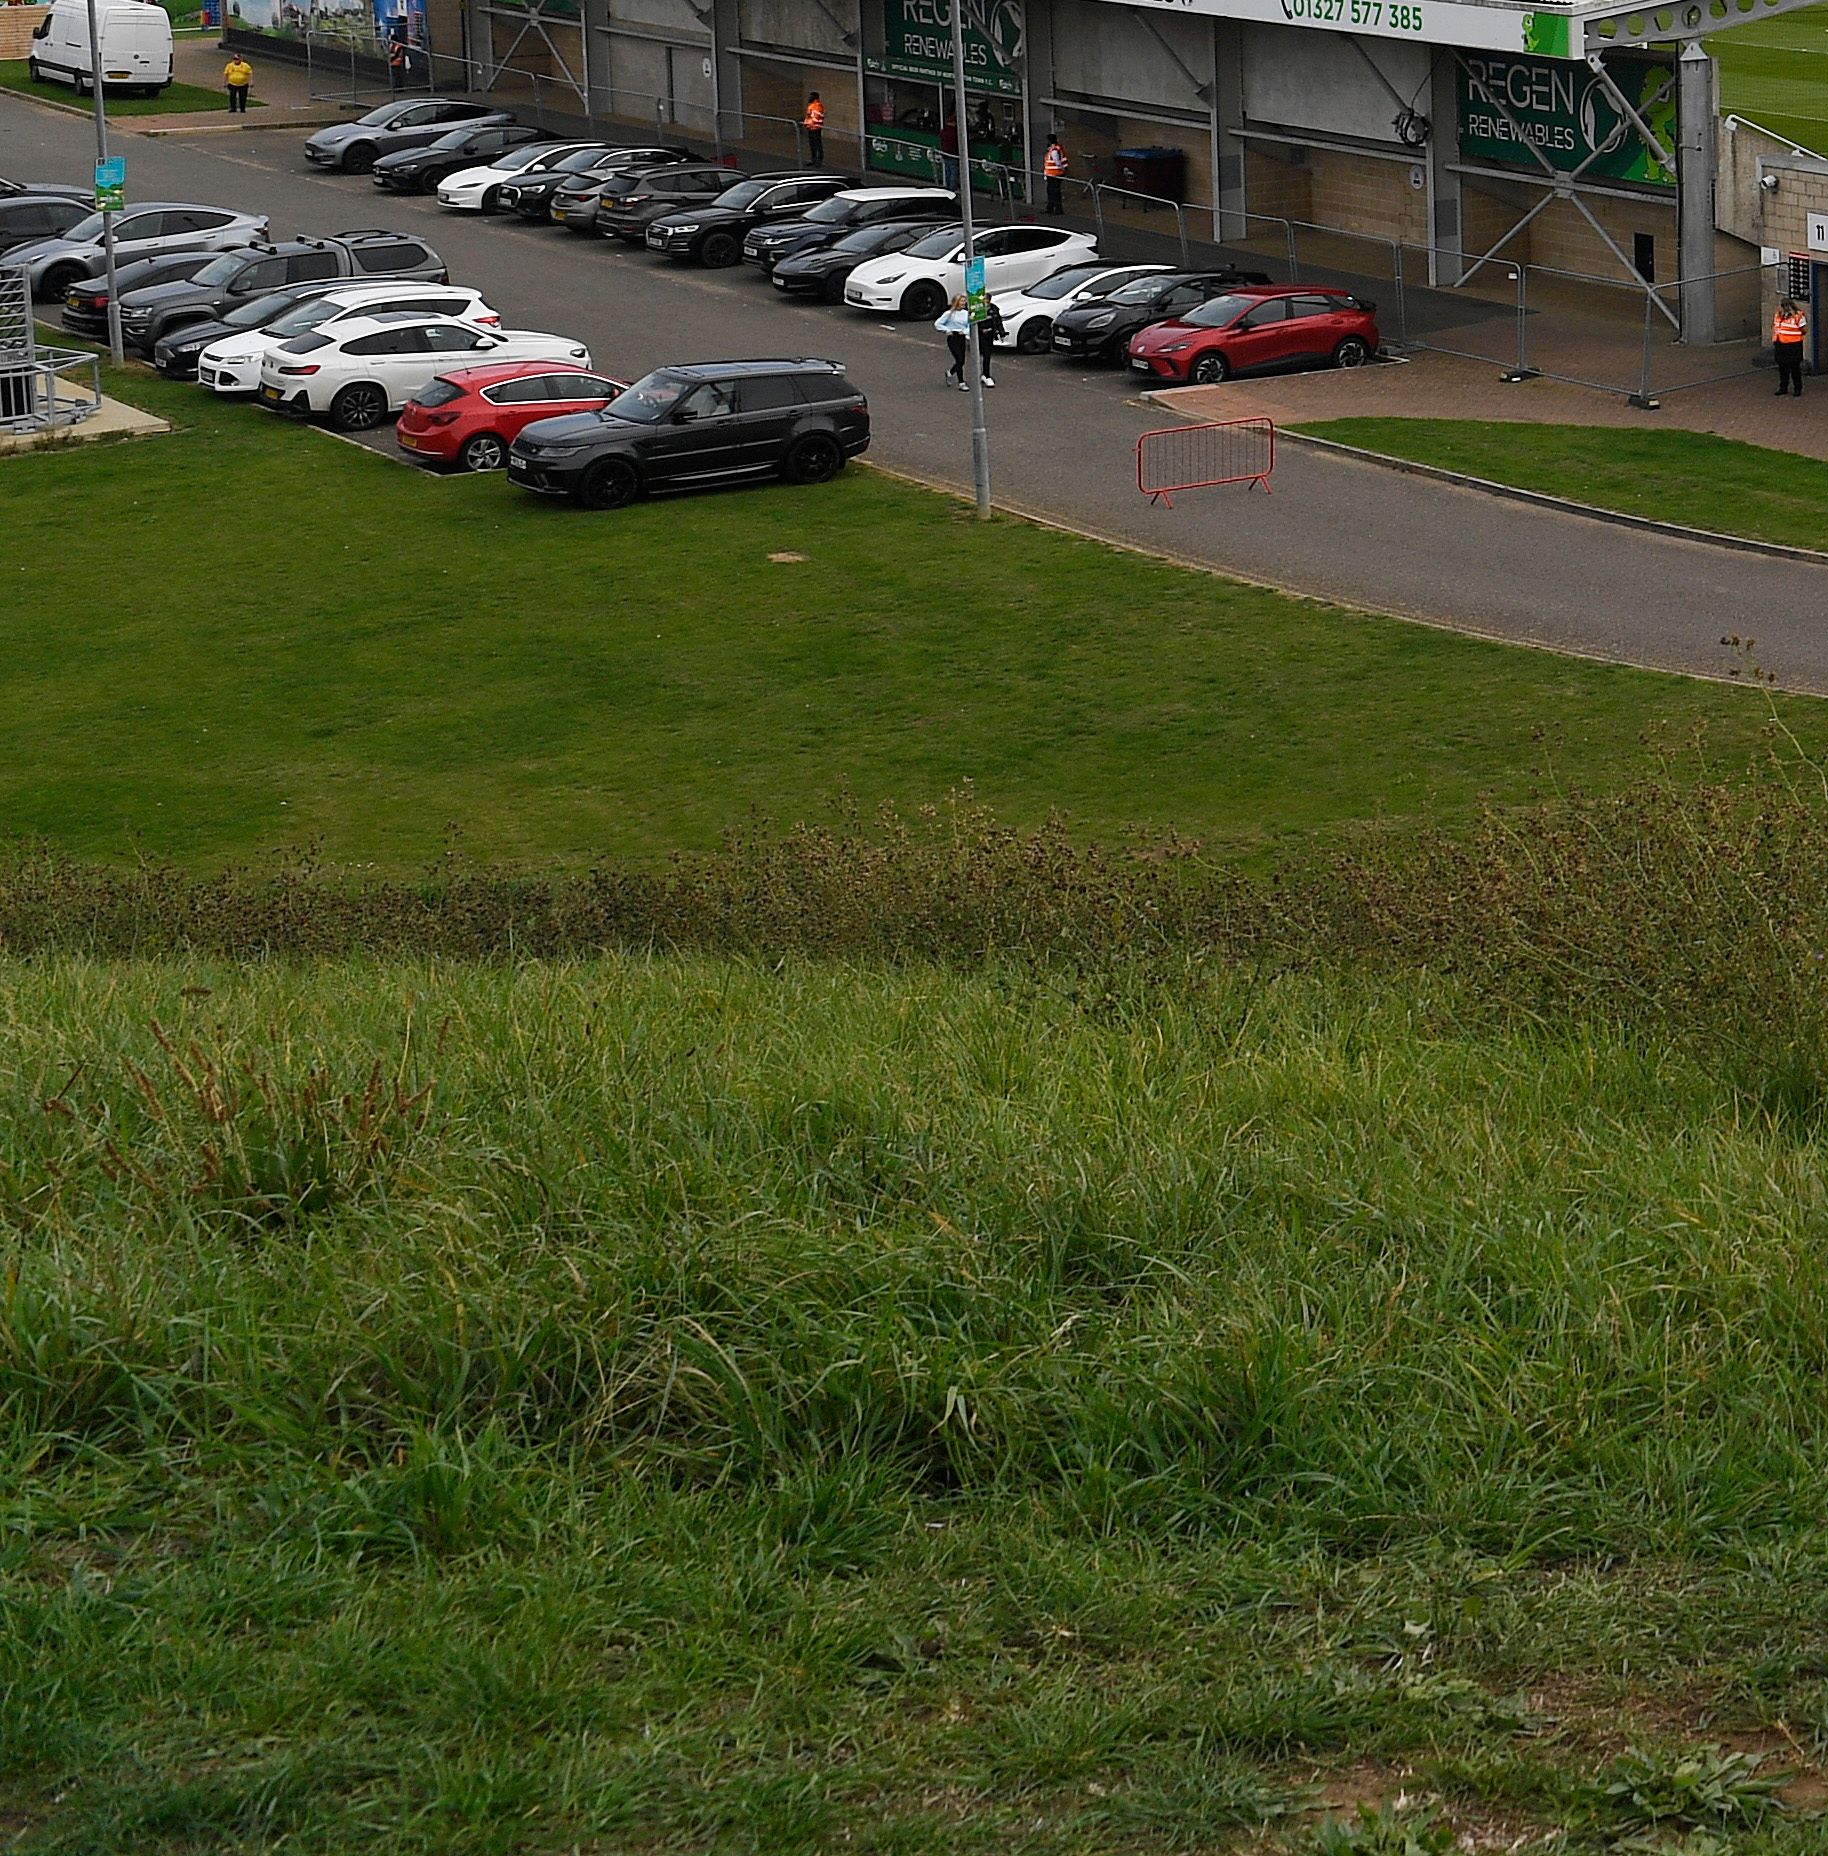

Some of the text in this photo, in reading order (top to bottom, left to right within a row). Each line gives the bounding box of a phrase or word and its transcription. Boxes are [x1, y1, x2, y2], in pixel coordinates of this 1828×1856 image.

[1350, 0, 1382, 26] 577
[1389, 4, 1423, 32] 385
[1468, 59, 1575, 115] REGEN
[1469, 114, 1575, 150] RENEWABLES
[1816, 224, 1825, 241] 11
